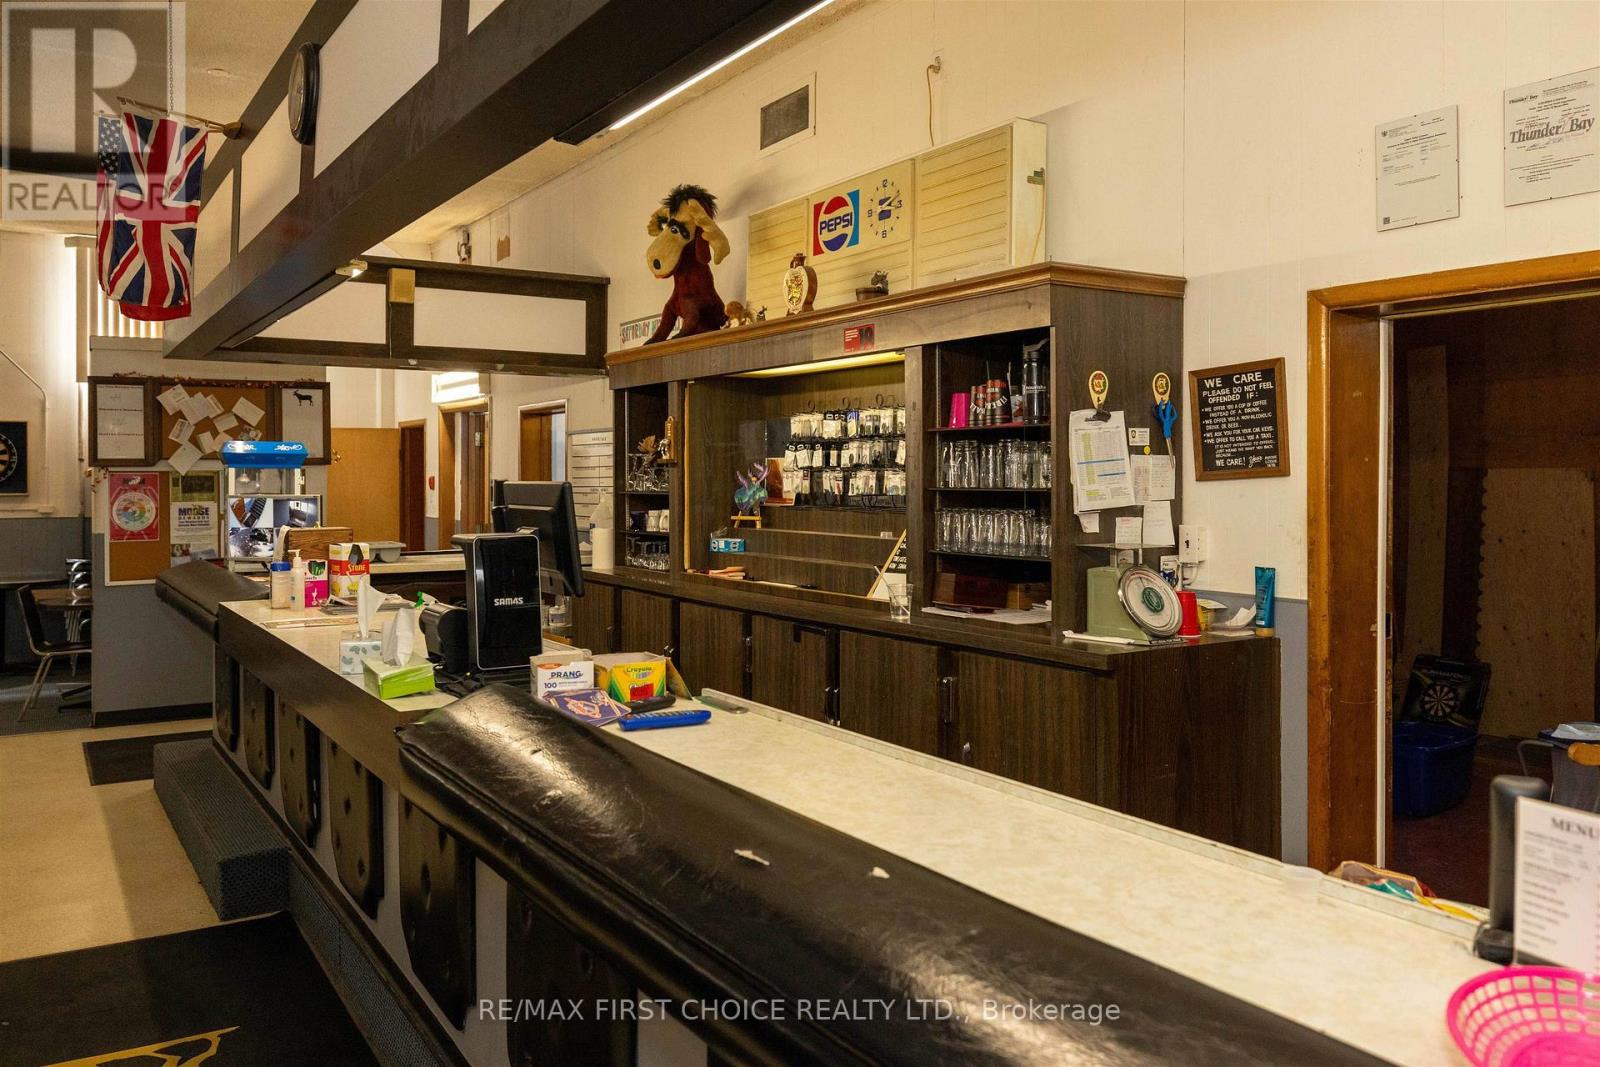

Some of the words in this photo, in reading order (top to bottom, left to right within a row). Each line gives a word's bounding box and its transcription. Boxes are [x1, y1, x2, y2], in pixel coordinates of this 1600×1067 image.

[1510, 121, 1563, 144] Thunder
[1570, 117, 1595, 132] Bay
[820, 212, 852, 235] PEPSI
[1204, 378, 1222, 388] WE
[1233, 372, 1262, 384] CARE
[1203, 388, 1230, 397] PLEASE
[1244, 384, 1257, 392] NOT
[1208, 394, 1240, 404] OFFENDED
[1226, 457, 1245, 466] CARE!
[179, 507, 209, 516] MOOSE
[551, 671, 581, 679] PRANG
[1551, 816, 1600, 839] MENU
